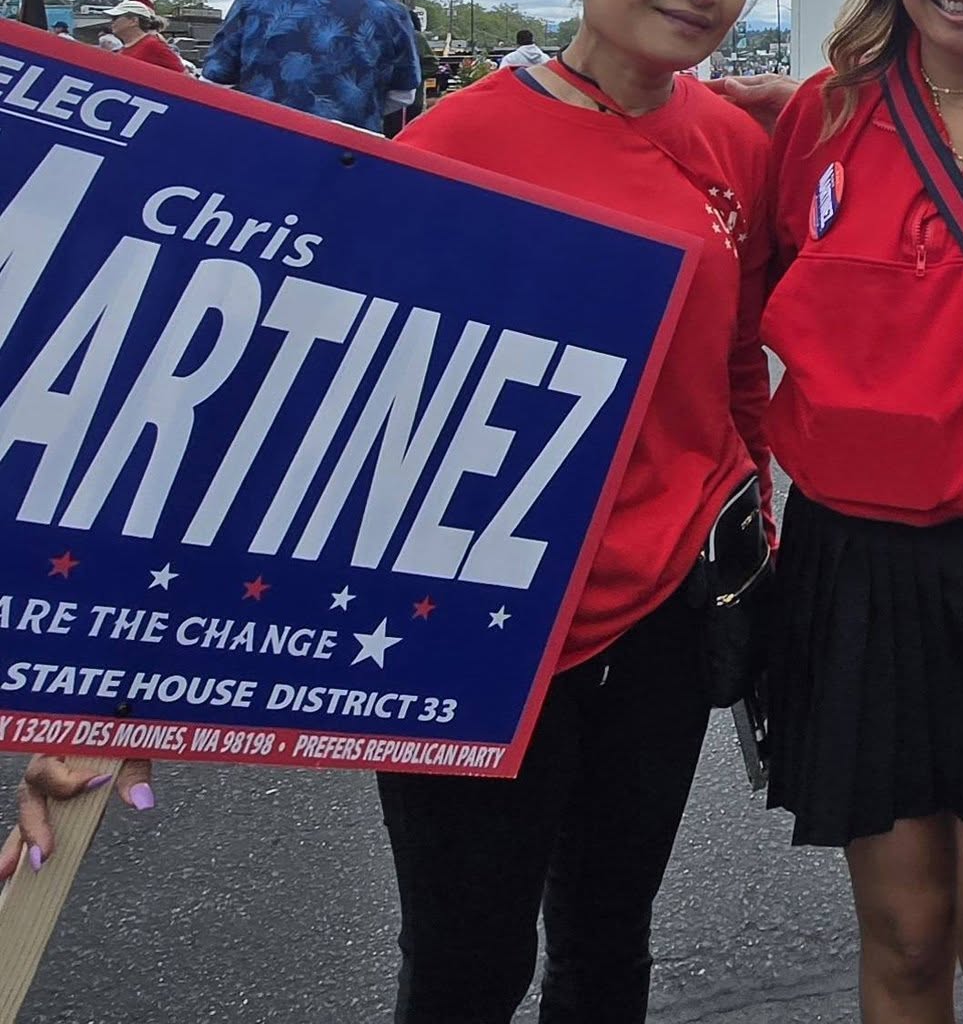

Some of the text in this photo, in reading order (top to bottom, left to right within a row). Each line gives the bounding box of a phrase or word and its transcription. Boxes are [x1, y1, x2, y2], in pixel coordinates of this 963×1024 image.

[142, 186, 323, 267] Chris
[0, 144, 627, 590] ARTINEZ
[88, 606, 169, 643] THE
[176, 616, 338, 659] CHANGE
[1, 662, 458, 722] STATE HOUSE DISTRICT 33
[12, 718, 75, 744] 13207
[72, 721, 114, 747] DES
[111, 723, 187, 754] MOINES,
[190, 727, 220, 753] WA
[220, 730, 275, 755] 98198
[292, 735, 364, 761] PREFERS
[363, 739, 458, 766] REPUBLICAN
[455, 745, 506, 769] PARTY
